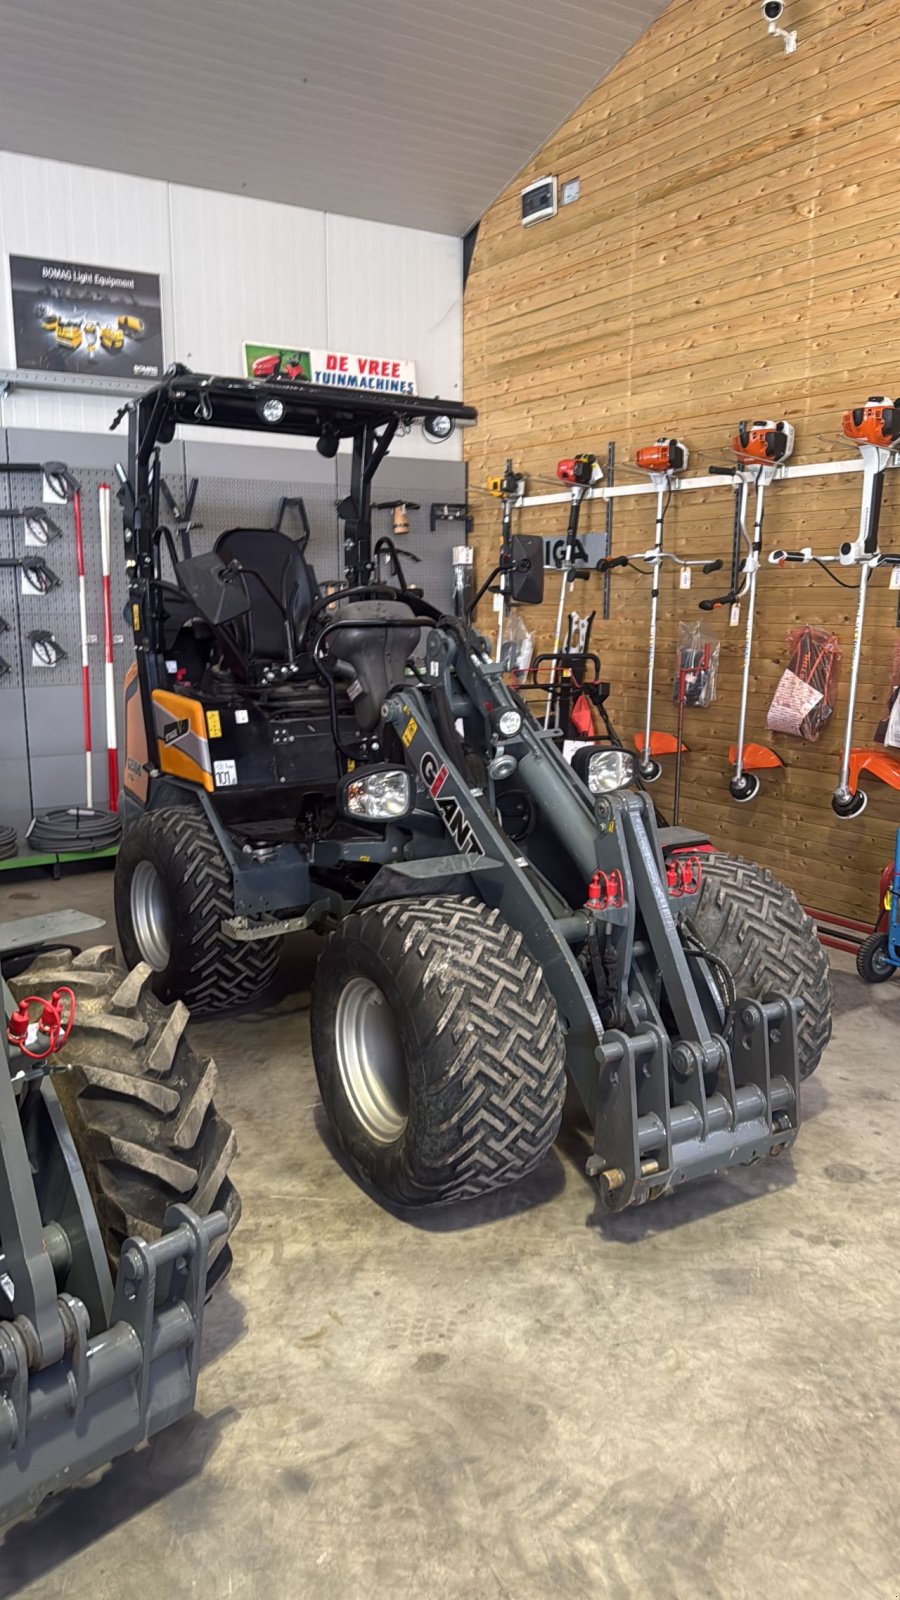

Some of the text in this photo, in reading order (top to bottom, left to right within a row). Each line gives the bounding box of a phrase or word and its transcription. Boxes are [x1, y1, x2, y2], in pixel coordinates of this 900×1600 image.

[42, 266, 135, 290] BOMAG Light Equipment
[326, 354, 401, 378] DE VREE
[315, 371, 415, 394] TUINMACHINES
